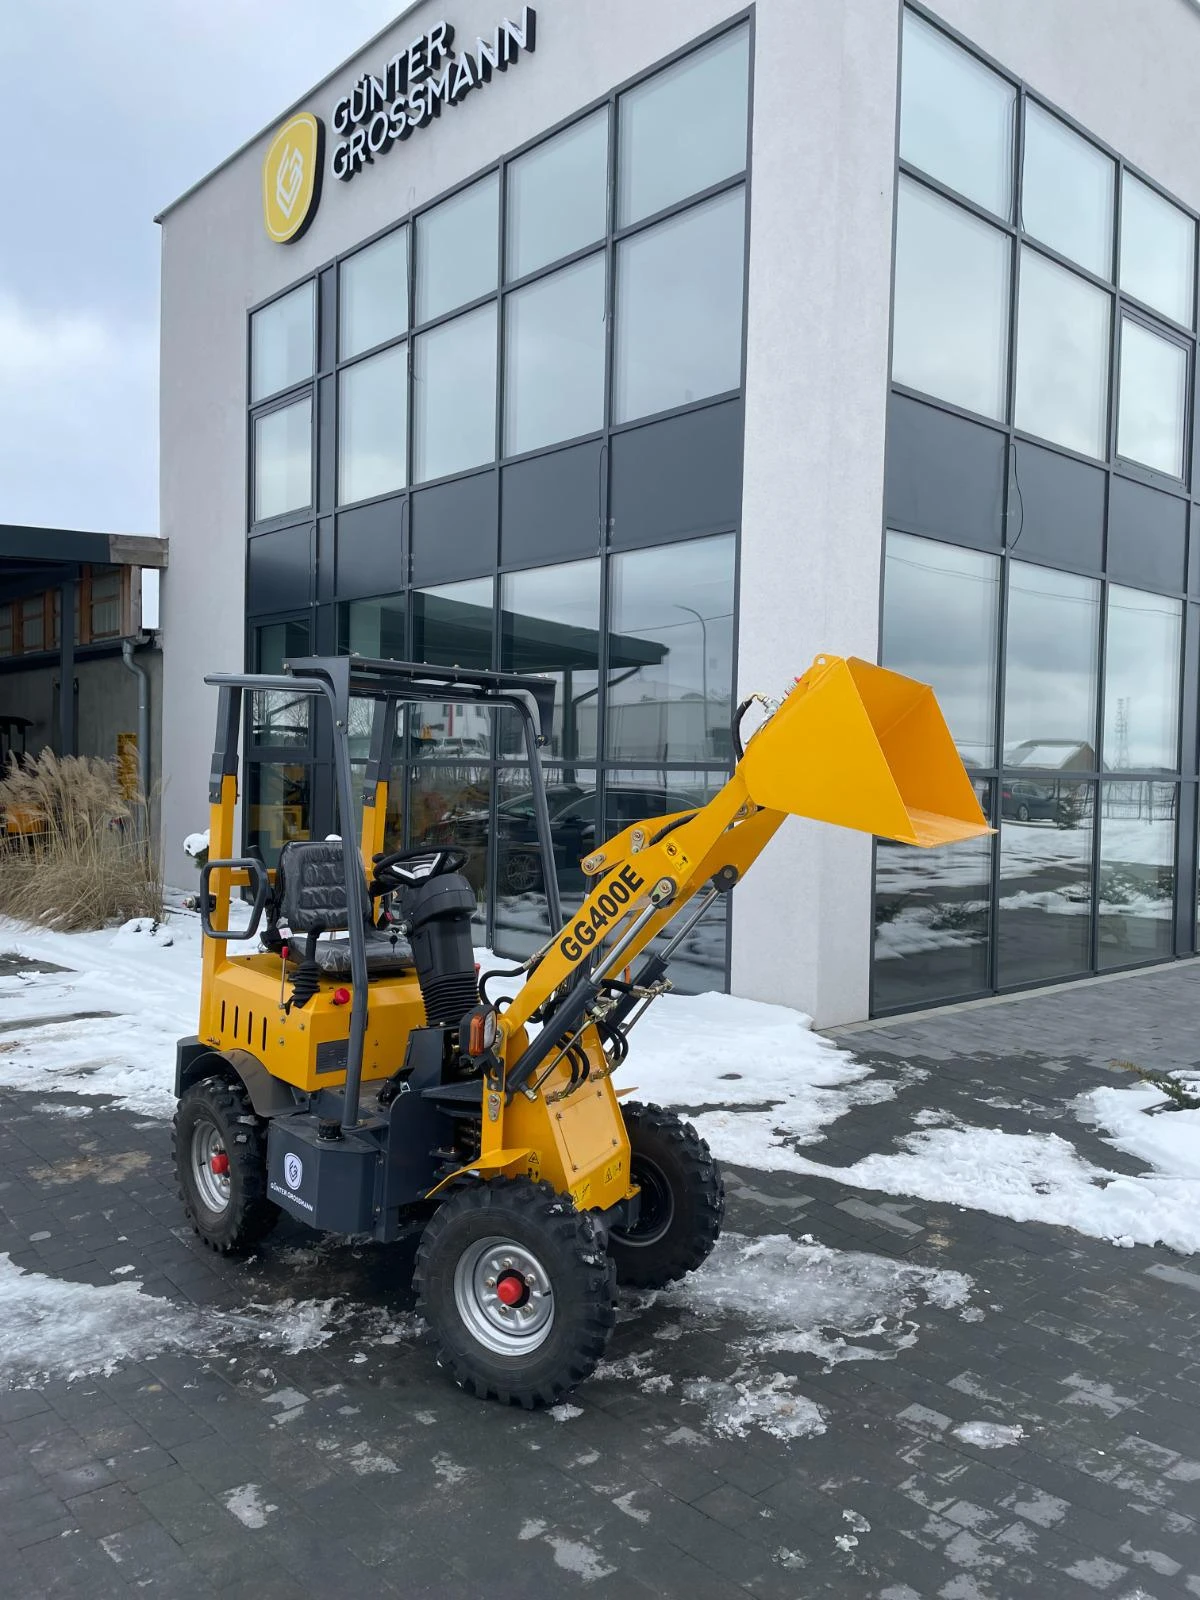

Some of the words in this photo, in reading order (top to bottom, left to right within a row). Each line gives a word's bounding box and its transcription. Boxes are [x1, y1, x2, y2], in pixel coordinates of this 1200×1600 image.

[331, 5, 537, 181] GROSSMANN
[332, 20, 455, 136] GÜNTER
[560, 864, 645, 962] GG400E
